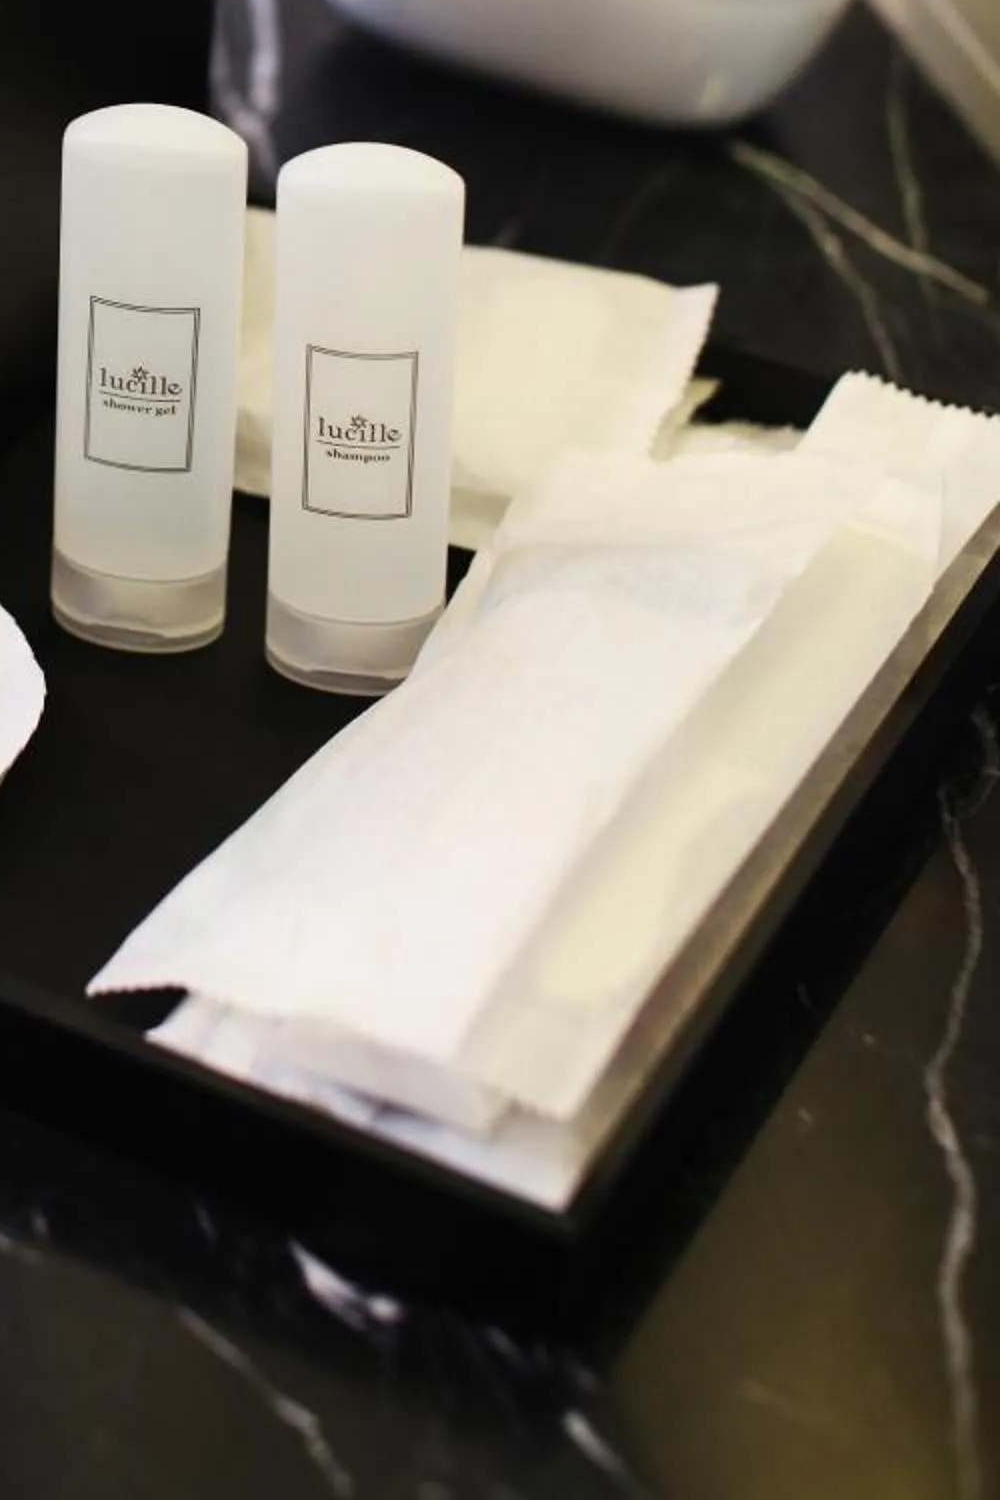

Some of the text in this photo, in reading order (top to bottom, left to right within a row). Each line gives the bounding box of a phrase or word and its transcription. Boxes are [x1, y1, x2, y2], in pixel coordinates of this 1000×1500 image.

[100, 367, 182, 395] lucille
[103, 398, 176, 417] shower gel
[318, 416, 402, 442] lucille
[326, 448, 391, 464] shampoo
